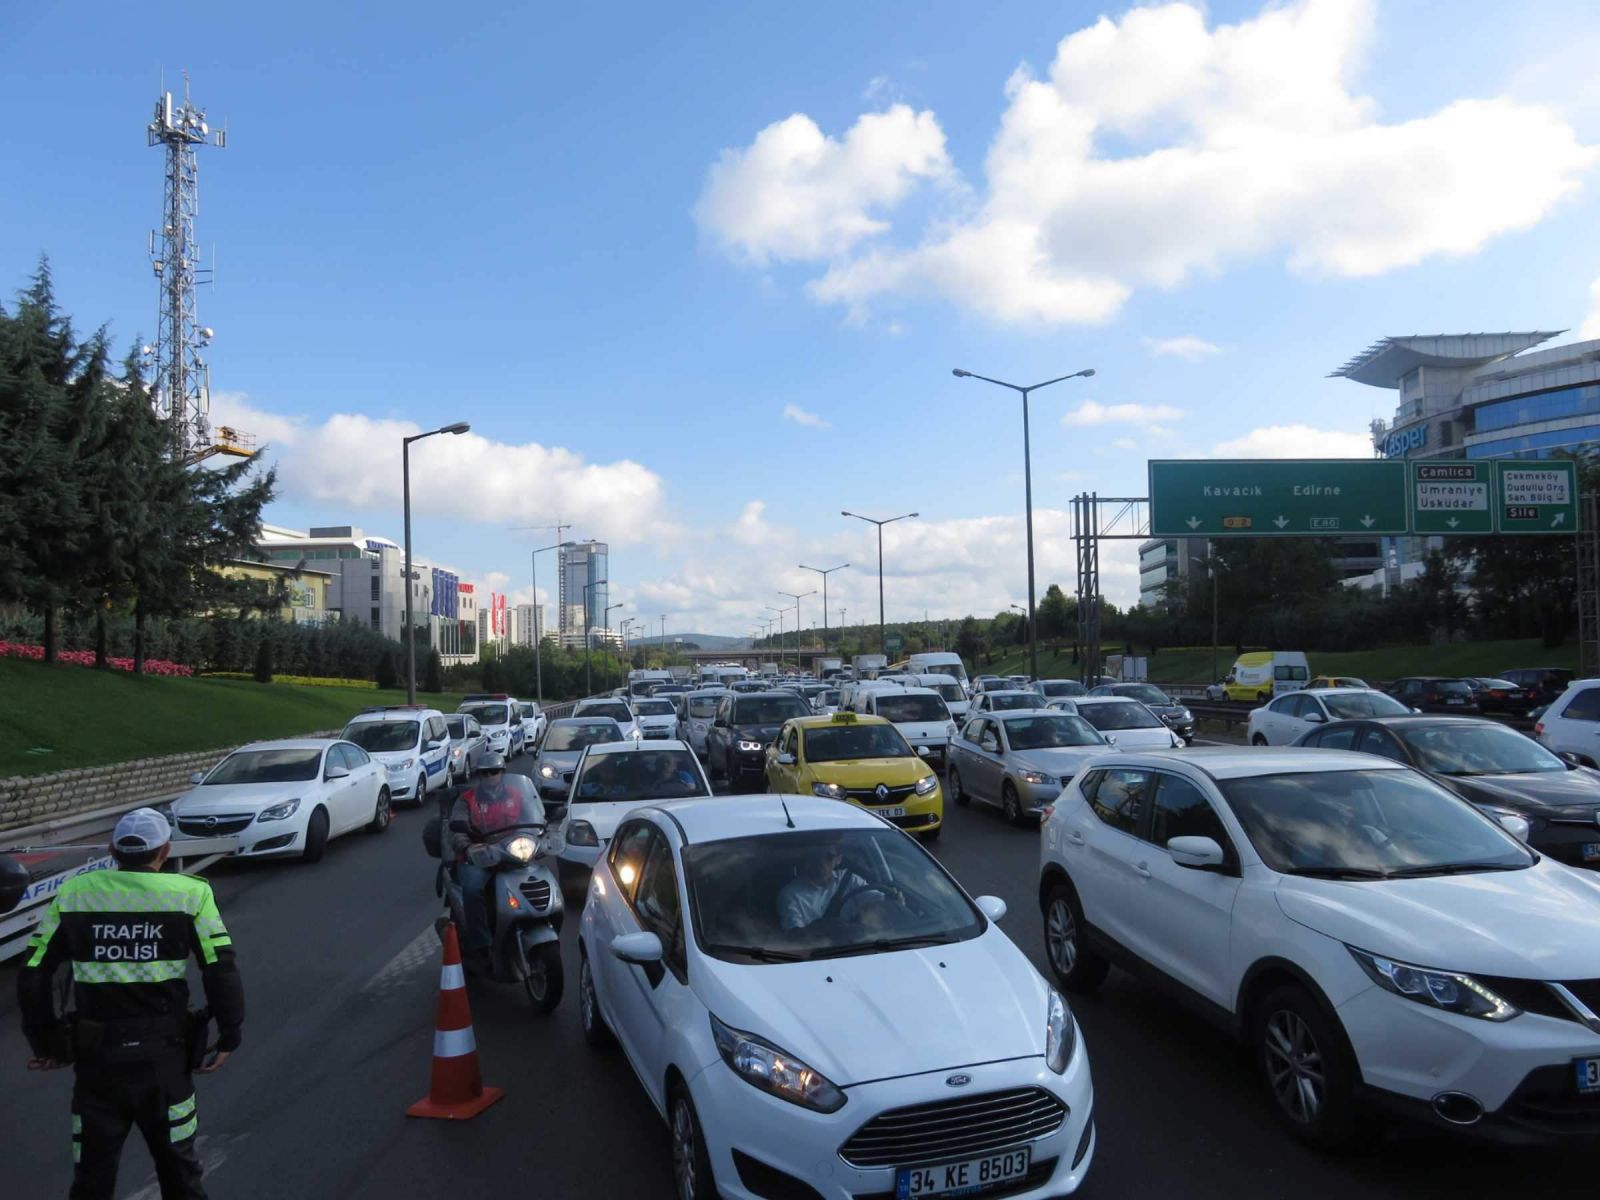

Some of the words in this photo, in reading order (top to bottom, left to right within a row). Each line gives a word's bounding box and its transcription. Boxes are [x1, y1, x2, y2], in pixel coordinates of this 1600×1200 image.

[1293, 484, 1341, 496] Edirne
[92, 921, 164, 939] TRAFİK
[94, 941, 159, 960] POLİSİ
[910, 1170, 936, 1194] 34
[945, 1163, 970, 1188] KE
[979, 1151, 1026, 1182] 8503
